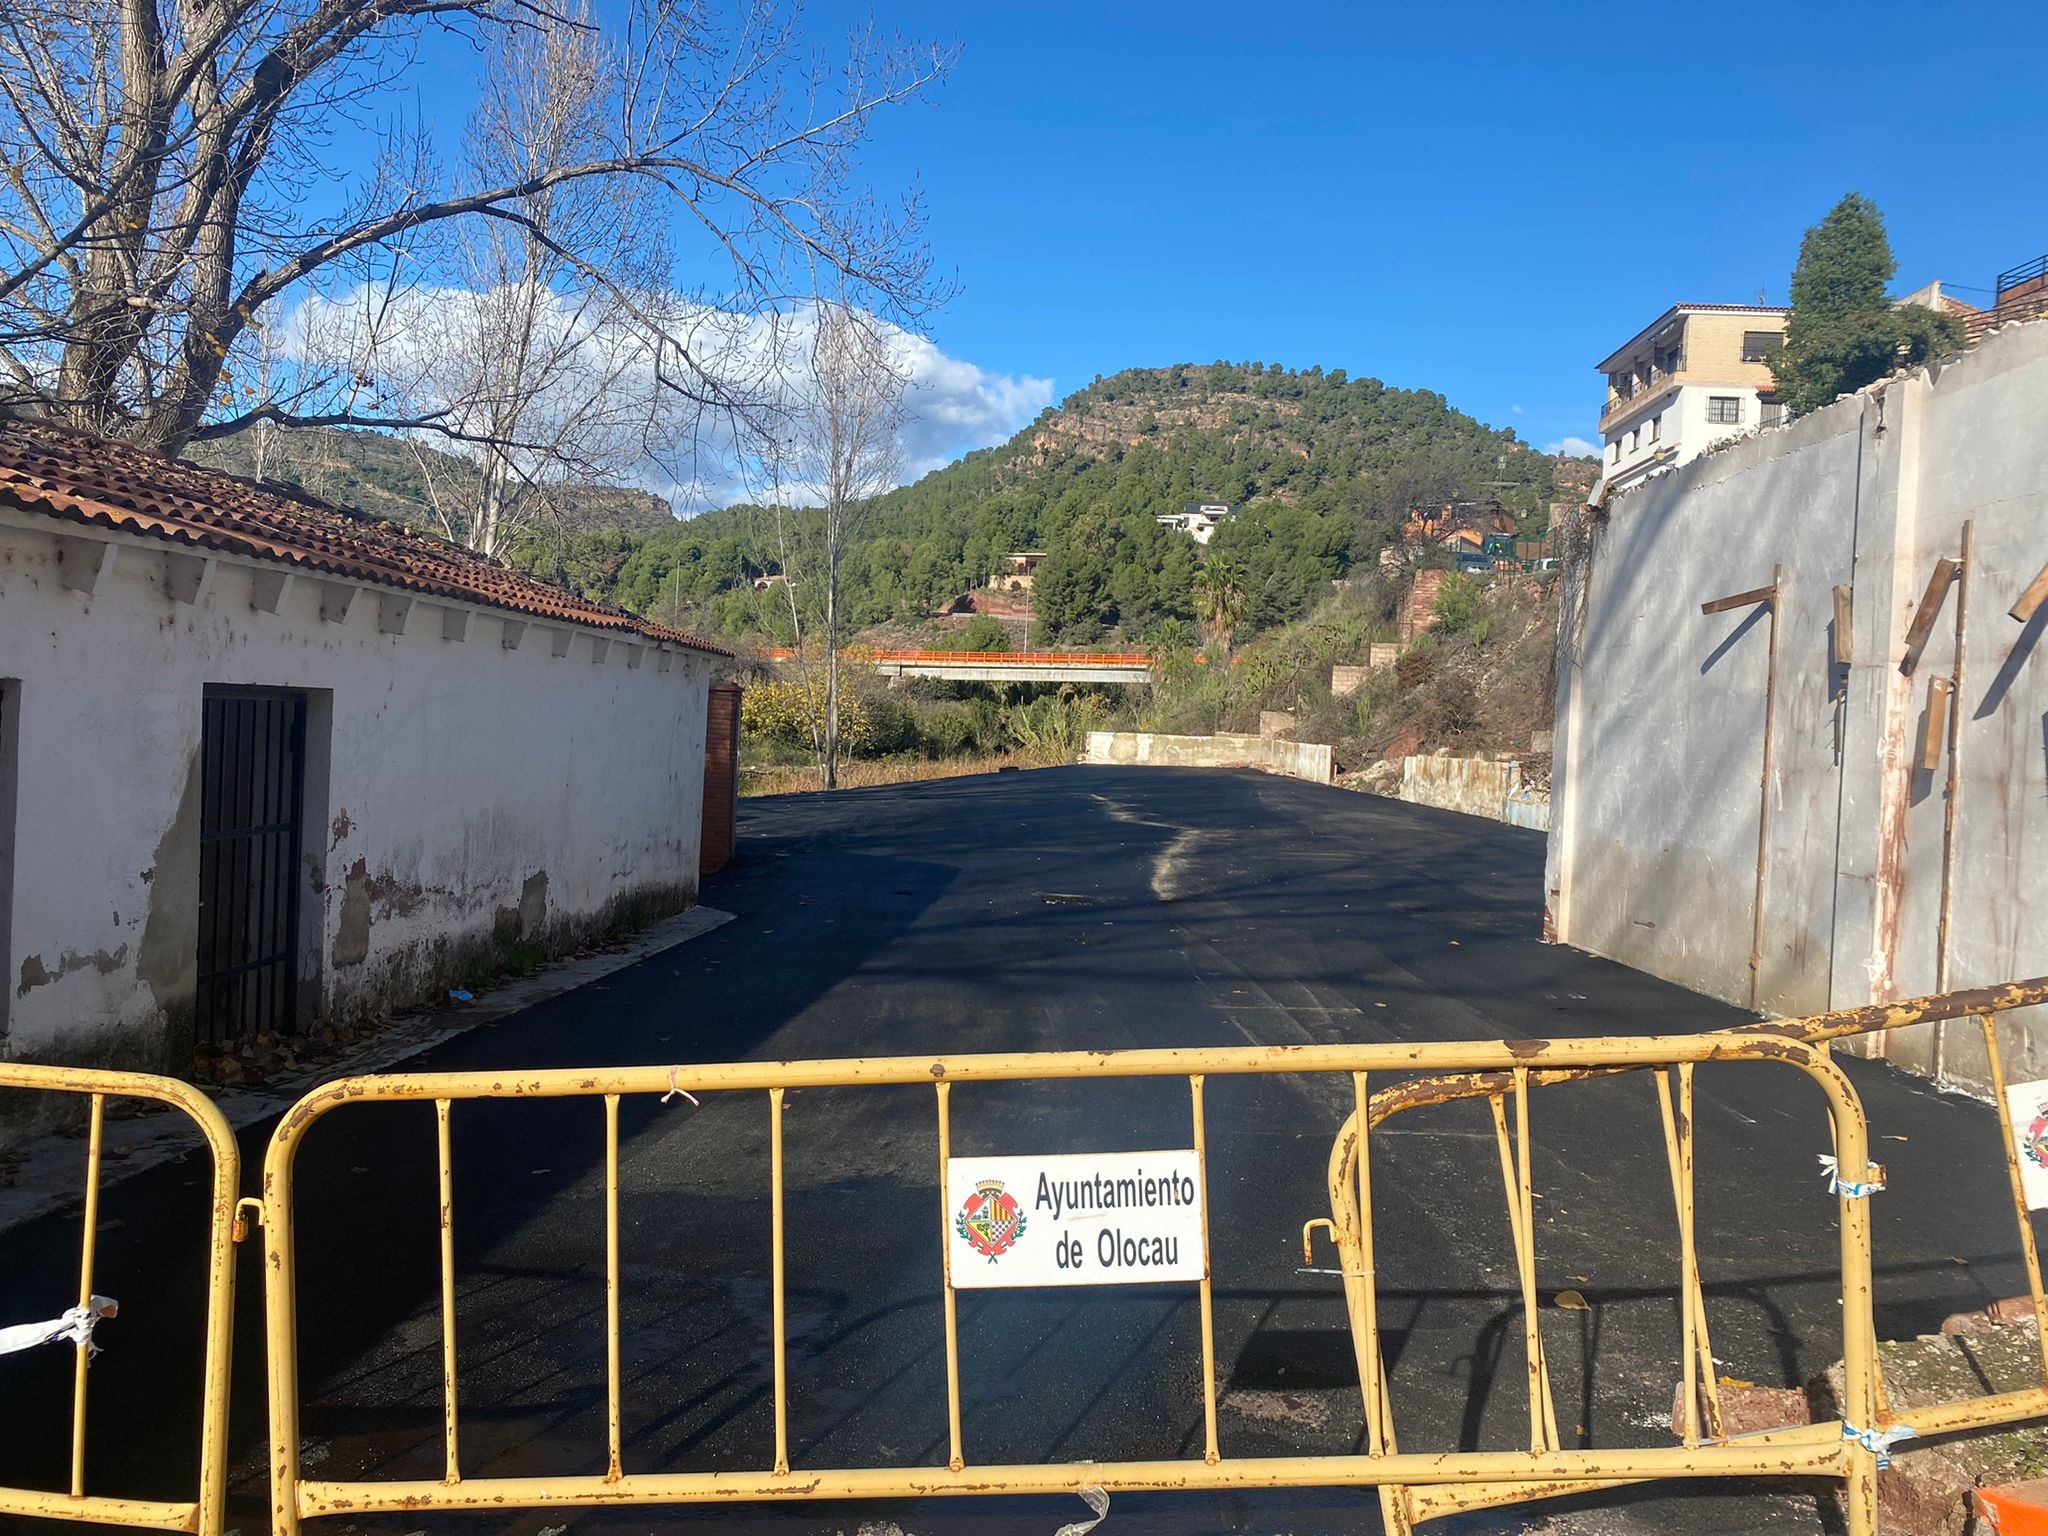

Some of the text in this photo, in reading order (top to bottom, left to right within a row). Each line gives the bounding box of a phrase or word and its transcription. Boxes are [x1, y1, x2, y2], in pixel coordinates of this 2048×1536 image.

[1035, 1169, 1194, 1220] Ayuntamiento
[1056, 1228, 1178, 1268] de Olocau
